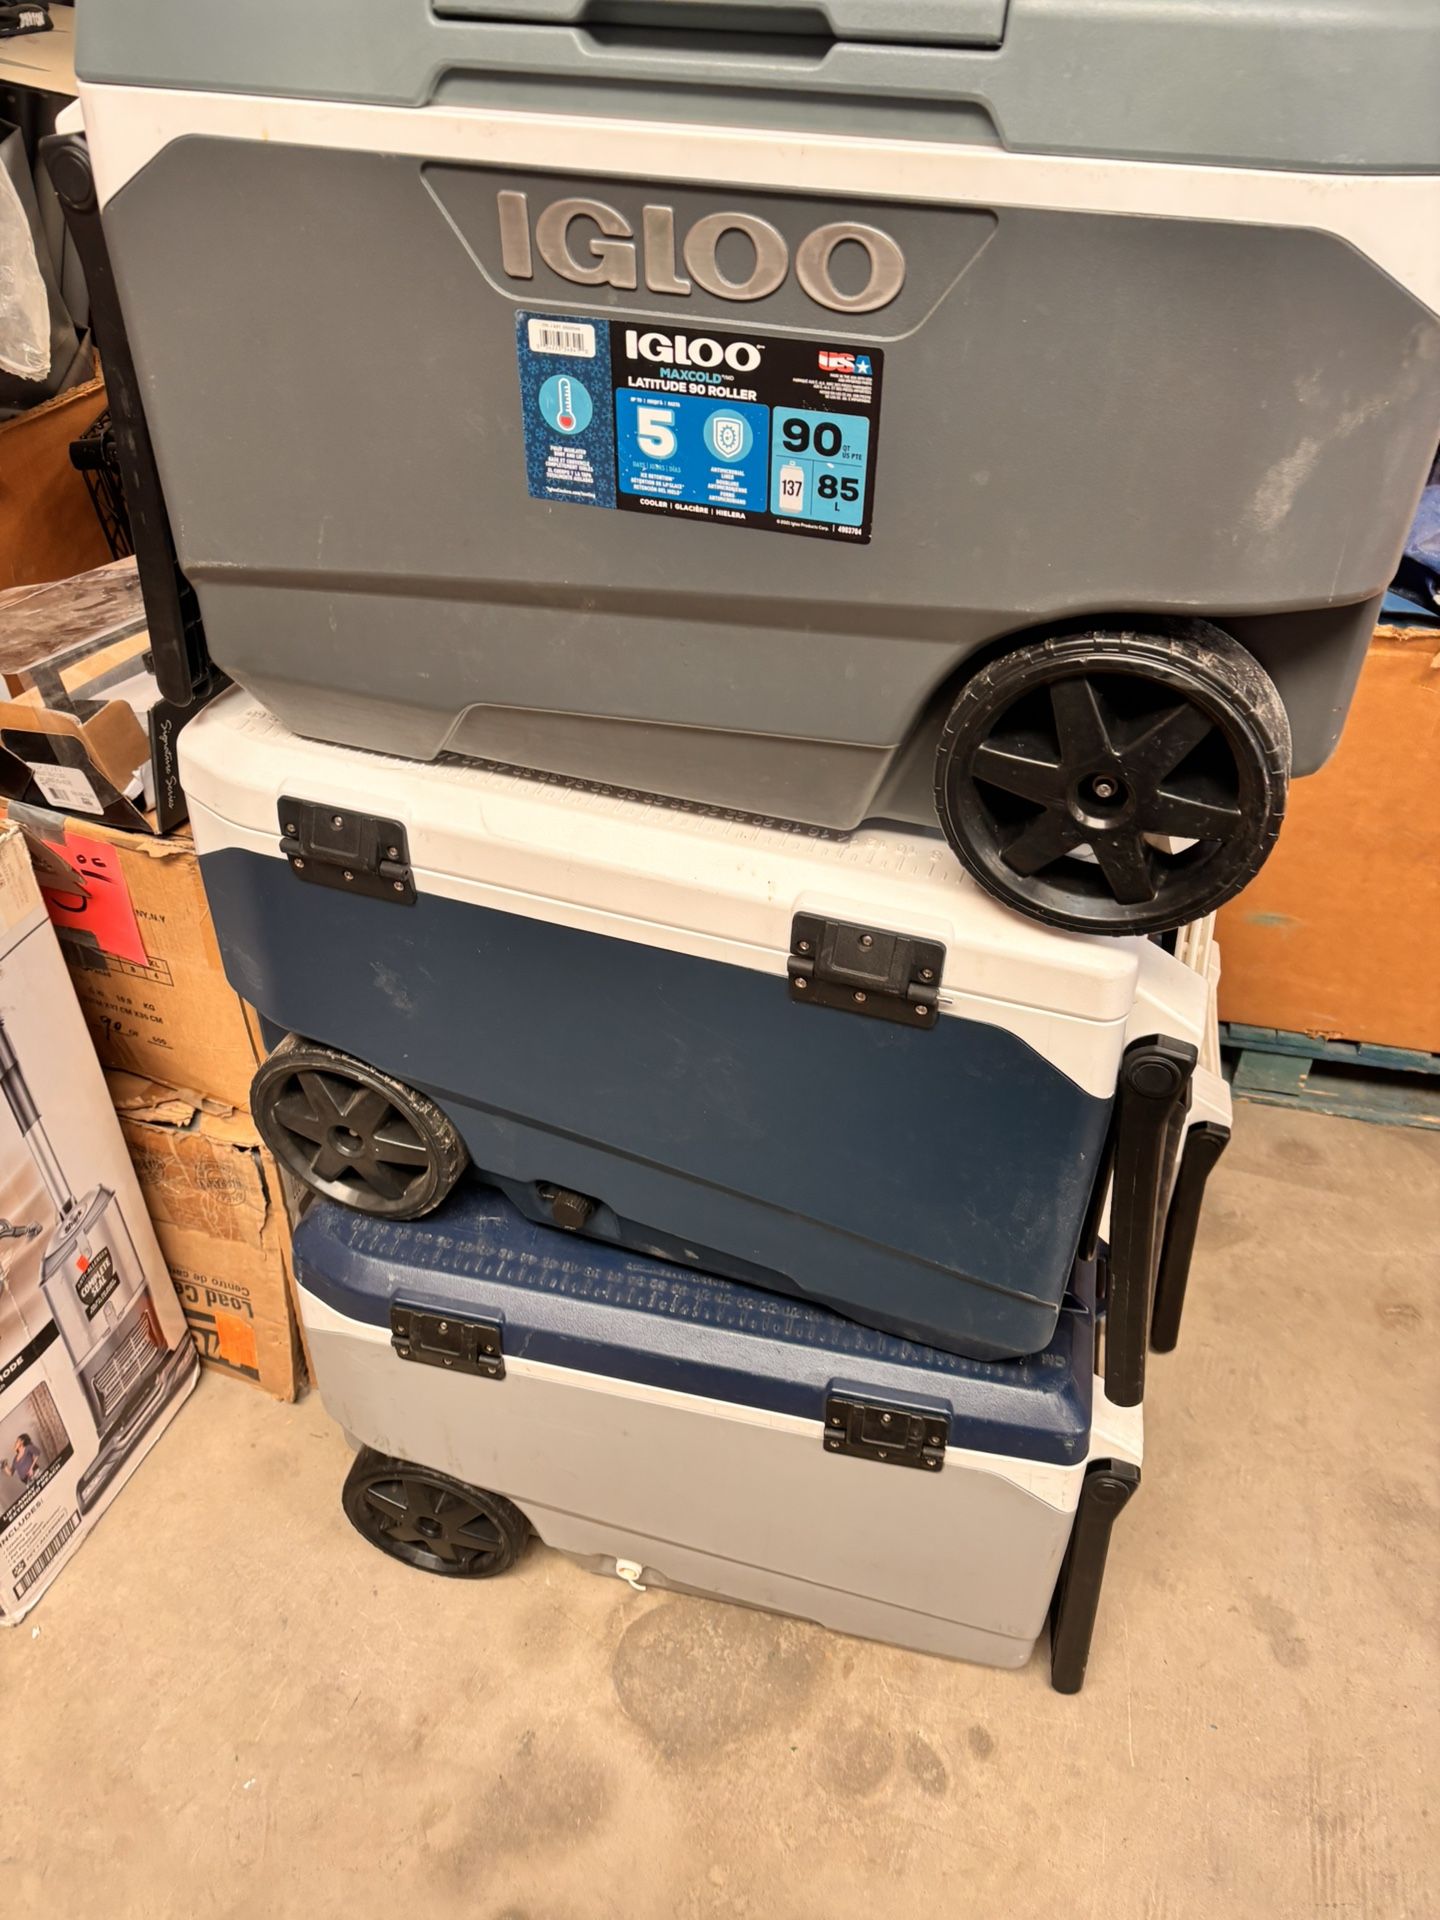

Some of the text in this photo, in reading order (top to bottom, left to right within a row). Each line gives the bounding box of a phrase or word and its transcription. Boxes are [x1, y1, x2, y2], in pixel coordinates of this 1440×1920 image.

[497, 189, 906, 313] IGLOO
[625, 330, 761, 372] IGLOO
[818, 351, 873, 376] USA
[628, 376, 757, 401] LATITUDE 90 ROLLER
[637, 405, 678, 460] 5
[782, 417, 842, 457] 90
[781, 479, 803, 497] 137
[817, 474, 859, 502] 85
[639, 498, 746, 519] COOLER GLACIÈRE HIELERA
[834, 502, 840, 512] L
[159, 719, 177, 809] Signature Series
[80, 1257, 111, 1298] COMPLETE
[193, 1273, 207, 1284] de
[212, 1278, 250, 1297] Centro
[205, 1288, 254, 1319] Load
